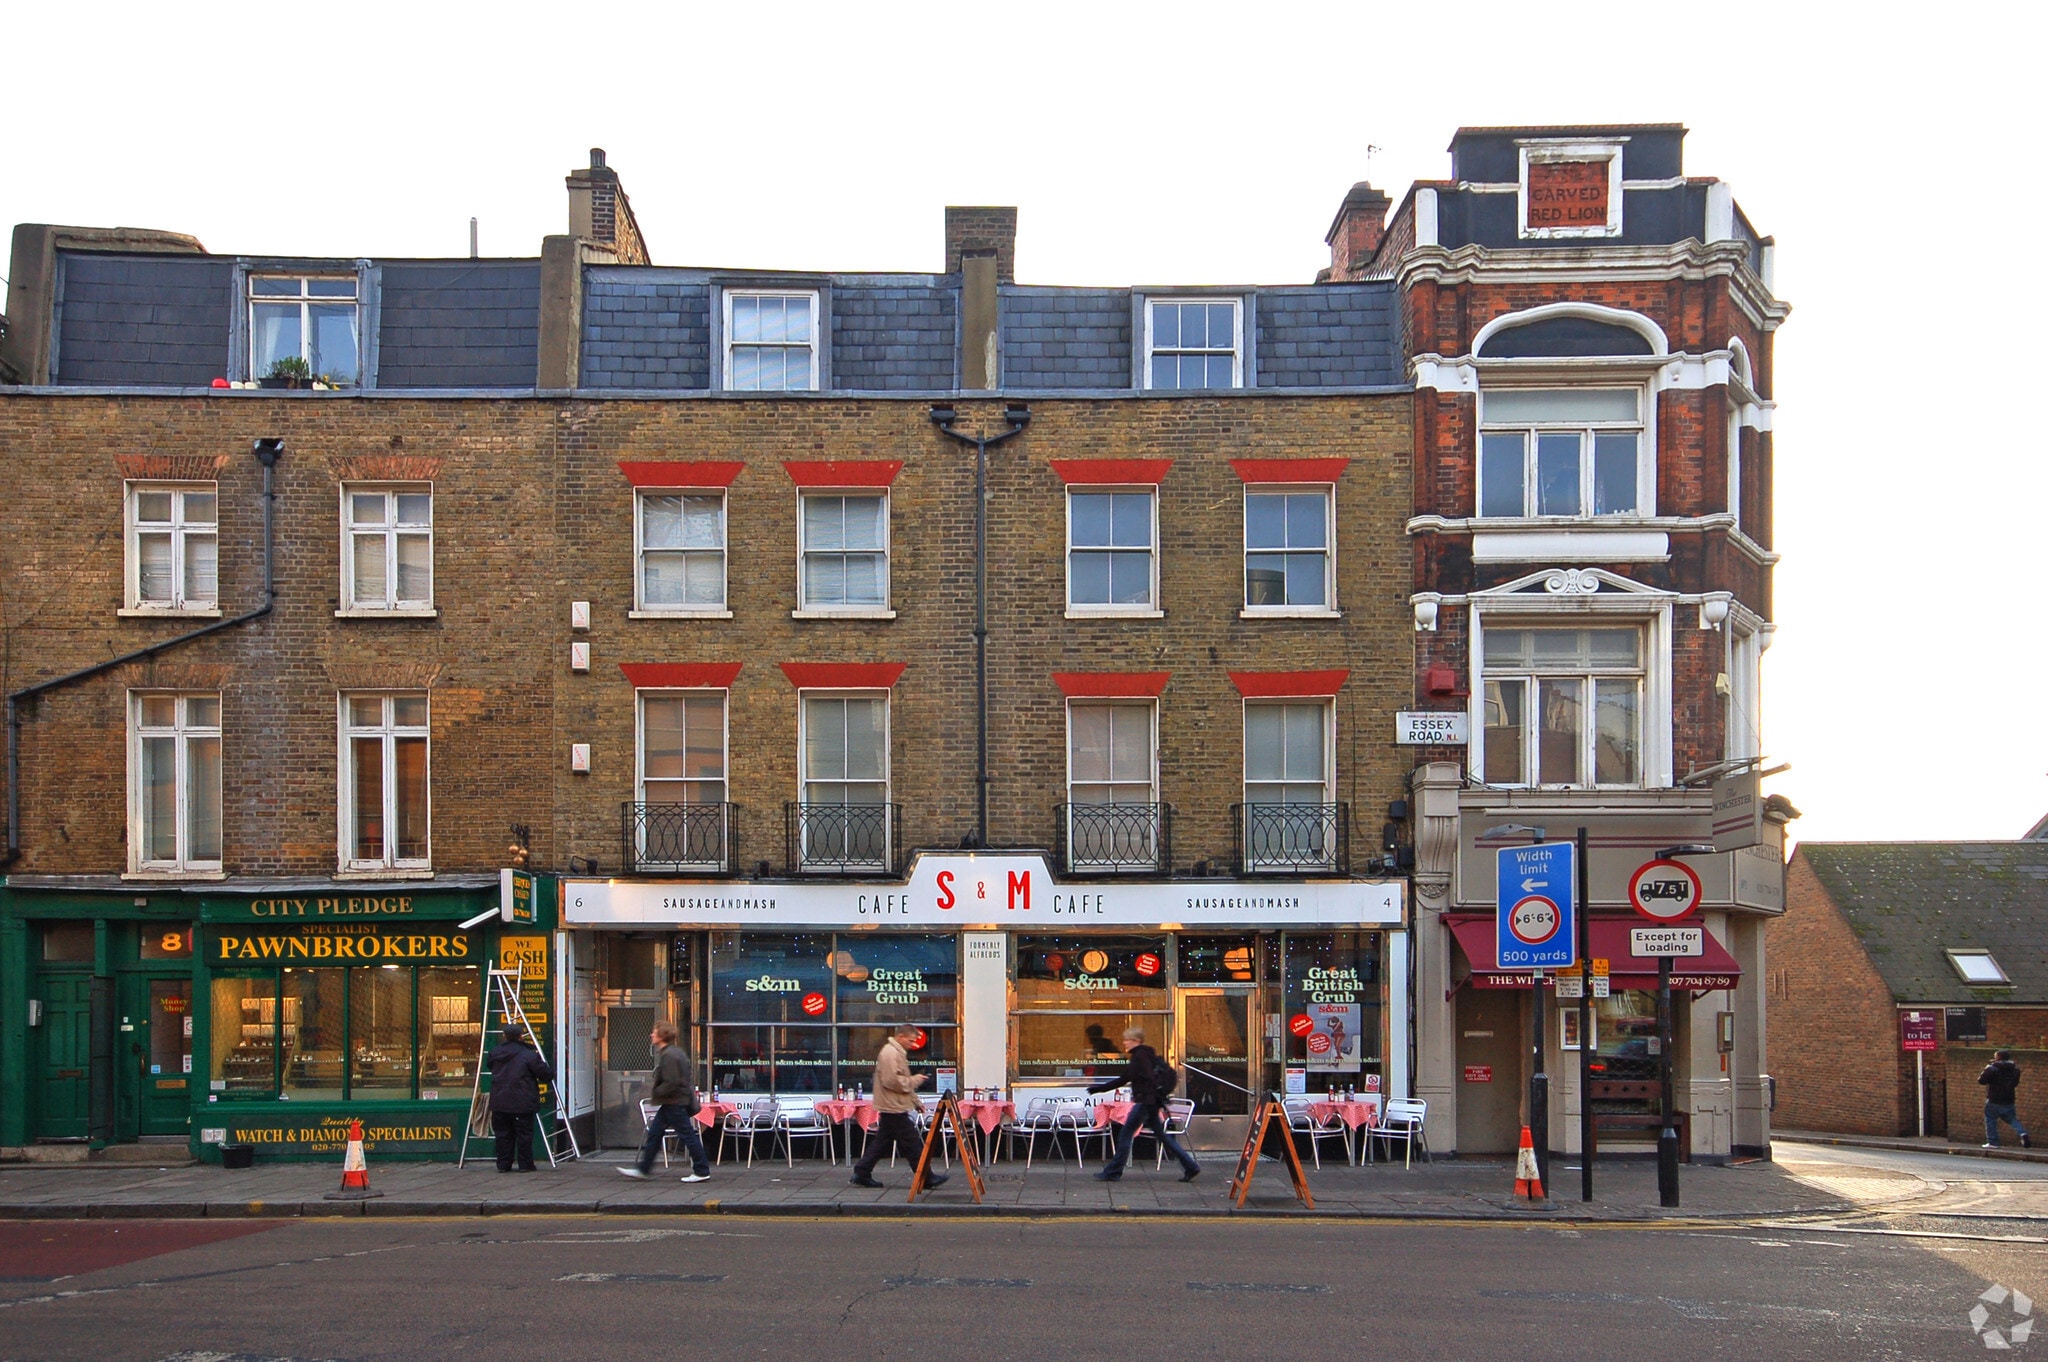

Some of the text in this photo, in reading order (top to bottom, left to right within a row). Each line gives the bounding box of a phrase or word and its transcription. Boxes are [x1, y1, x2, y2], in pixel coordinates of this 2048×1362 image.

[1532, 188, 1600, 200] CARVED
[1532, 208, 1604, 220] RED LION
[1412, 720, 1453, 730] ESSEX
[1714, 794, 1752, 812] WINCHESTER
[1516, 850, 1552, 862] Width
[1520, 863, 1548, 875] limit
[858, 870, 1104, 914] CAFE S & M CAFE
[250, 896, 414, 916] CITY PLEDGE
[575, 897, 583, 908] 6
[1384, 898, 1392, 908] 4
[302, 924, 378, 934] SPECIALIST
[162, 932, 182, 951] 8
[1636, 932, 1698, 942] Except for
[219, 935, 468, 958] PAWNBROKERS
[516, 940, 532, 948] WE
[1645, 943, 1688, 952] loading
[503, 950, 544, 964] CASH
[1503, 950, 1568, 962] 500 yards
[872, 968, 922, 980] Great
[1308, 967, 1358, 979] Great
[746, 975, 801, 992] s&m
[866, 980, 928, 992] British
[1064, 974, 1119, 990] s&m
[1302, 980, 1364, 991] British
[1488, 976, 1514, 984] THE
[1685, 977, 1702, 986] 704
[1704, 976, 1716, 986] 87
[1717, 976, 1730, 986] 89
[876, 992, 919, 1004] Grub
[1312, 992, 1354, 1003] Grub
[1318, 1004, 1348, 1013] s&m
[1920, 1031, 1931, 1039] let
[236, 1128, 282, 1142] WATCH
[286, 1128, 296, 1142] &
[368, 1126, 452, 1141] SPECIALISTS
